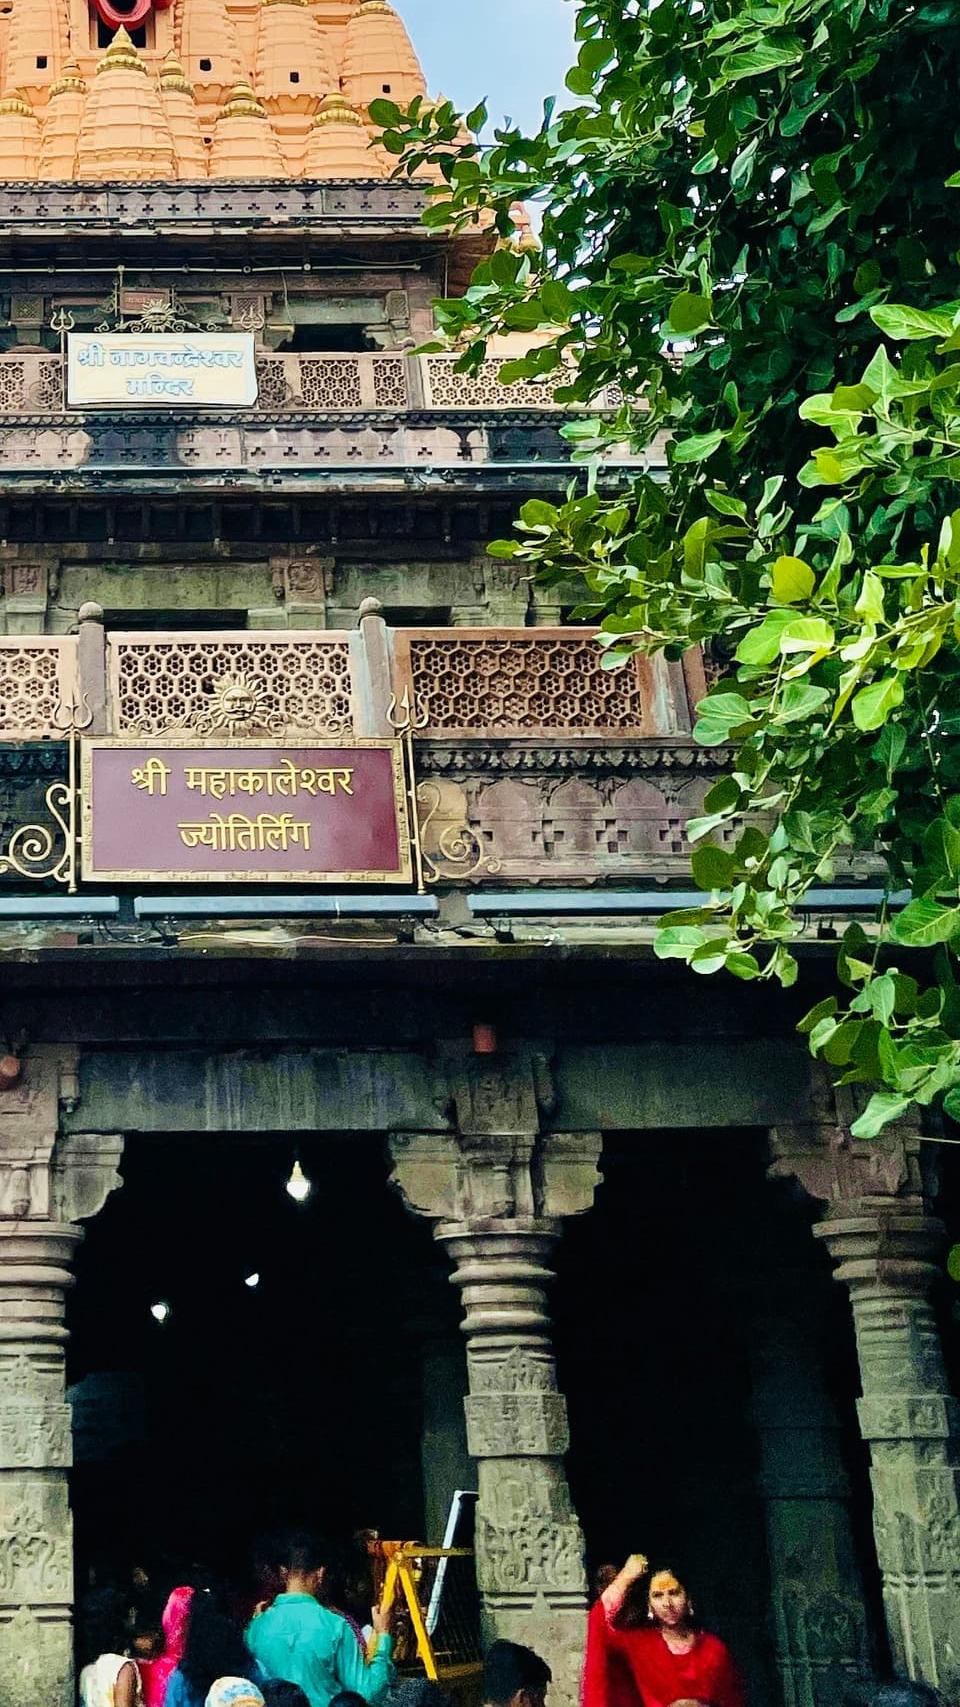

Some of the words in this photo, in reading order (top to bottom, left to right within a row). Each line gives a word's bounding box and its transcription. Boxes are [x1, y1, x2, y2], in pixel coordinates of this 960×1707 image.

[77, 342, 106, 367] श्री
[126, 372, 195, 396] मन्दिर
[130, 757, 172, 796] श्री
[183, 758, 355, 800] महाकालेश्वर
[177, 812, 311, 852] ज्योतिर्लिंग
